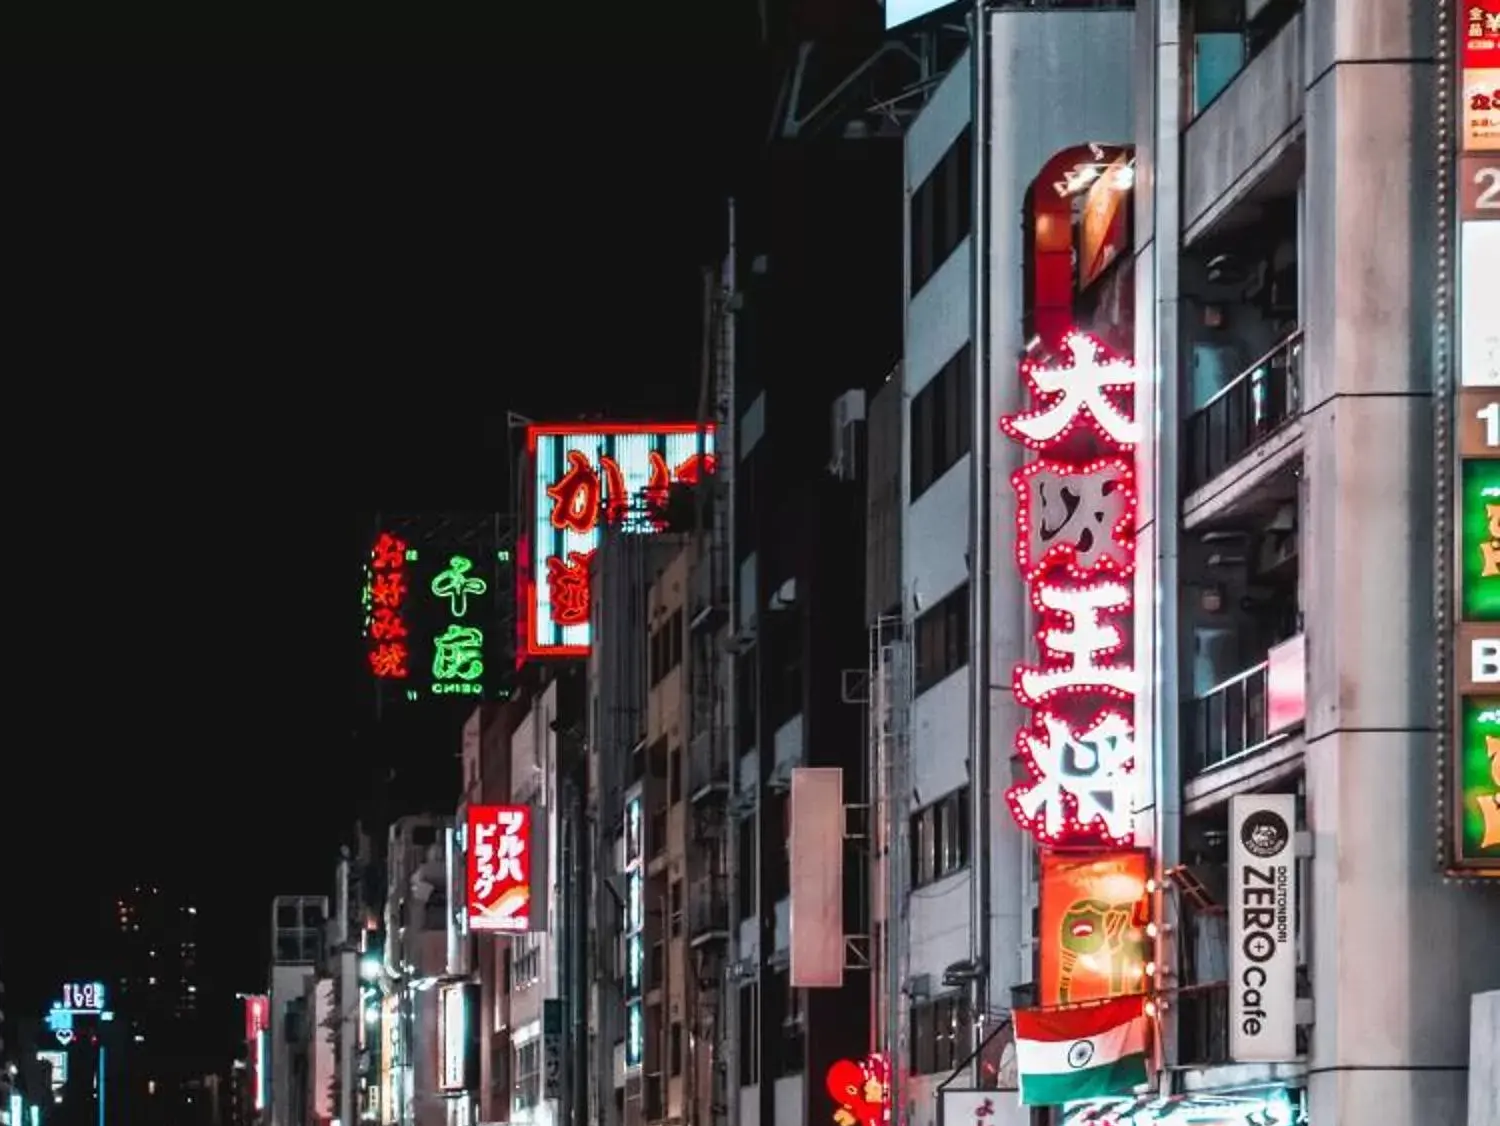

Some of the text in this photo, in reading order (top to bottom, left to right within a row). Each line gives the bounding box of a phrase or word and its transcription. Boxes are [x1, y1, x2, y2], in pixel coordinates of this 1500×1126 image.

[431, 555, 488, 681] 千房
[431, 682, 485, 695] CHIBO
[1242, 865, 1276, 964] ZERO
